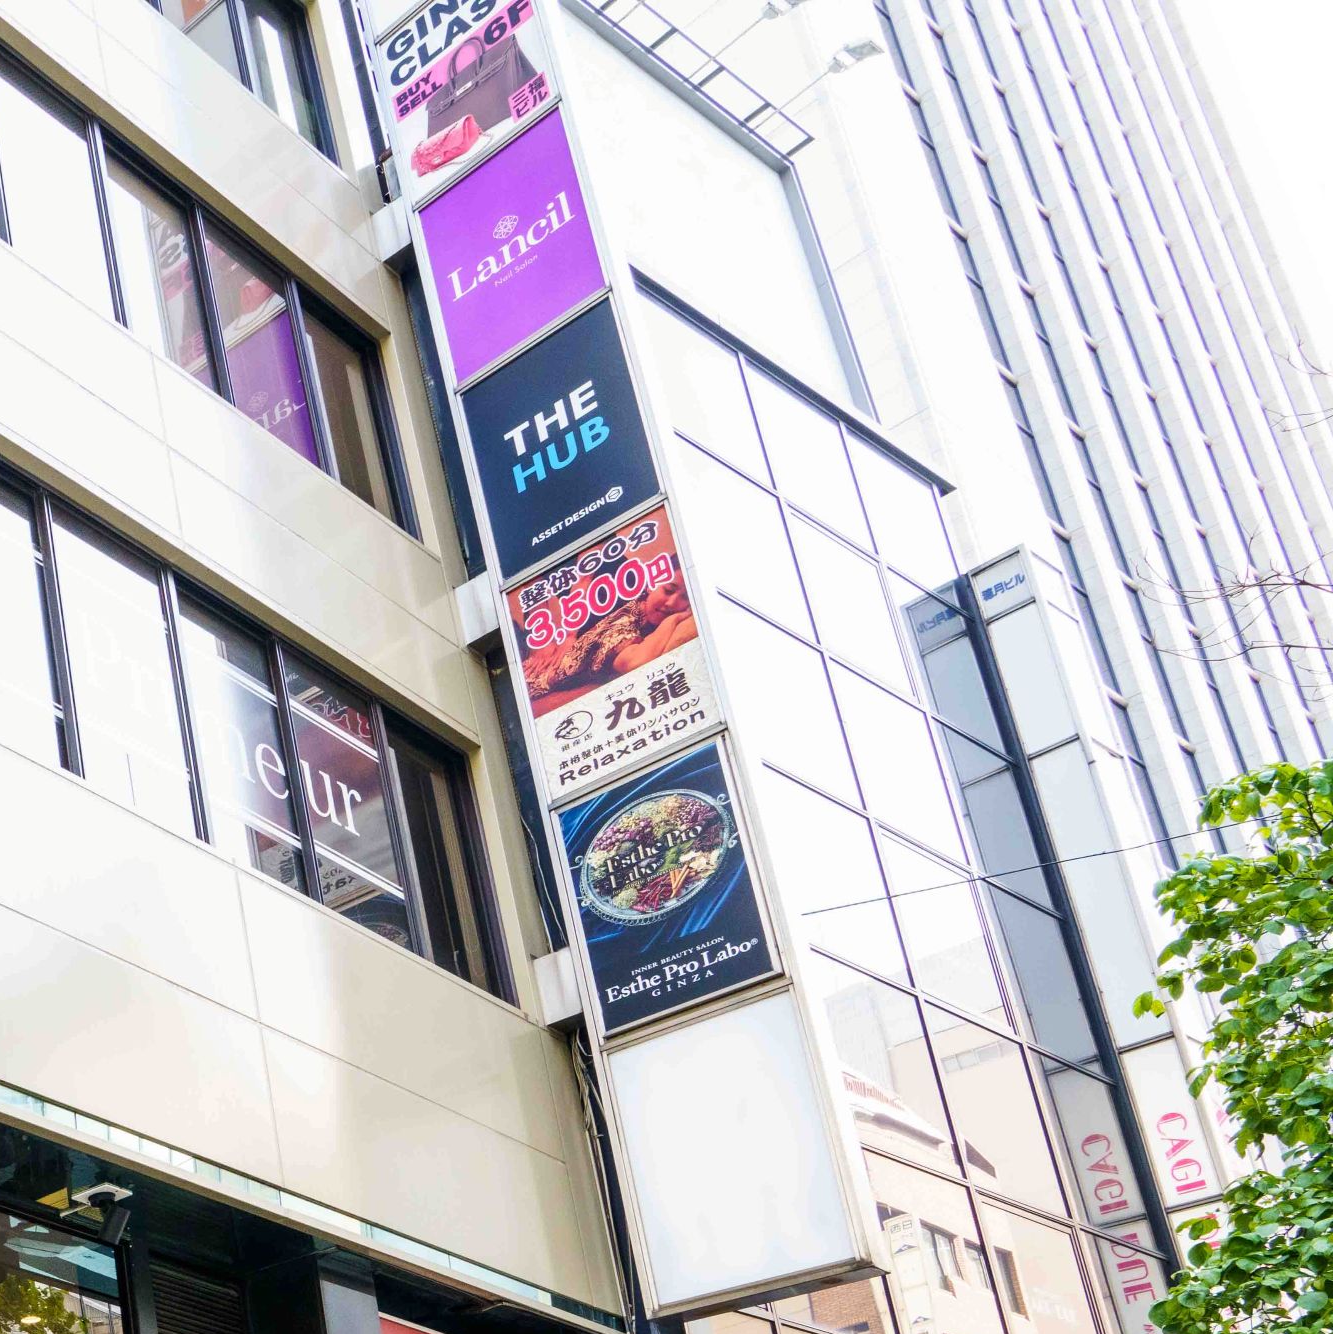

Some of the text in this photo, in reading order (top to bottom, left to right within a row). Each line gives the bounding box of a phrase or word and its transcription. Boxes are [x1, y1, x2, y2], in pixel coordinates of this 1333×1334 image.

[386, 0, 469, 61] GIN
[483, 1, 530, 46] 6F
[396, 70, 432, 107] BUY
[399, 81, 443, 118] SELL
[447, 190, 576, 302] Lancil
[503, 380, 599, 457] THE
[512, 415, 610, 494] HUB
[531, 496, 606, 547] ASSET DESIGN
[519, 520, 659, 612] 整体60分
[524, 553, 676, 651] 3,500円
[605, 667, 691, 731] 九龍
[560, 709, 706, 786] Relaxation
[665, 825, 703, 848] Pro
[606, 970, 661, 1004] Esthe
[663, 955, 700, 983] Pro
[631, 935, 725, 975] INNER BEAUTY SALON
[651, 968, 716, 998] GINZA
